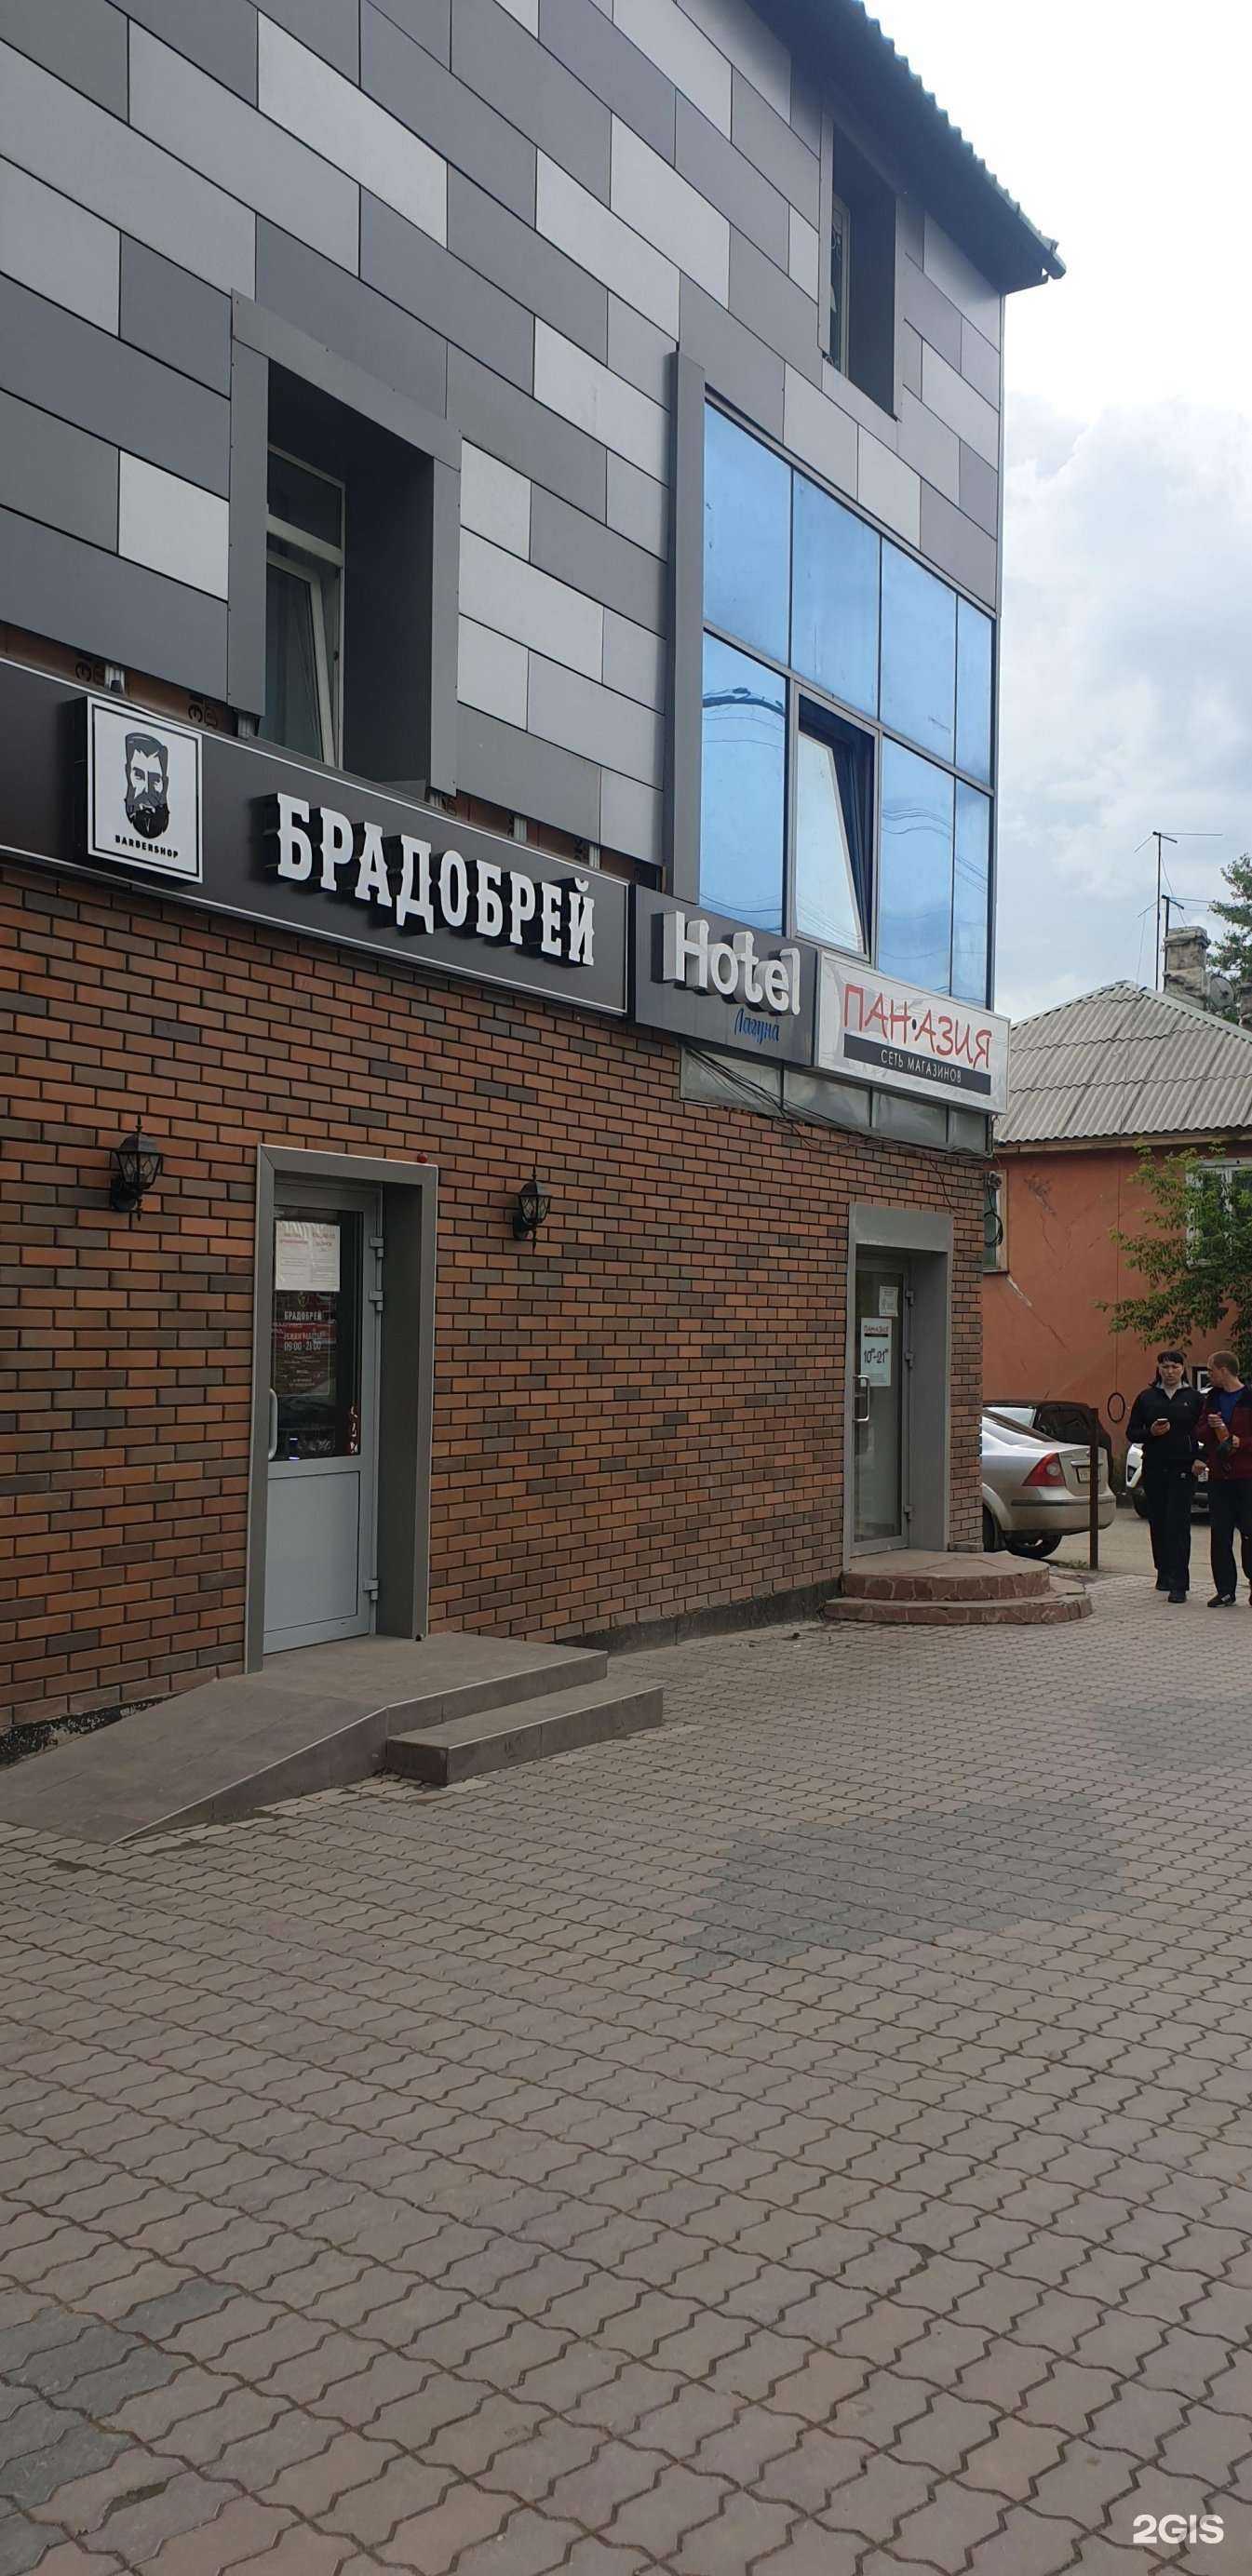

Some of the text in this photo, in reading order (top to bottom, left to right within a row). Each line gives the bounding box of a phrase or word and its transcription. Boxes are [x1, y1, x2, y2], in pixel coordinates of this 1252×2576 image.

[114, 835, 179, 858] BARBERSHOP
[277, 793, 595, 966] БРАДОБРЕЙ
[663, 910, 801, 1016] Hotel
[734, 1008, 780, 1044] Лагуна
[881, 1049, 962, 1083] СЕТЬ МАГАЗИНОВ
[284, 1310, 322, 1321] БРАДОБРЕЙ
